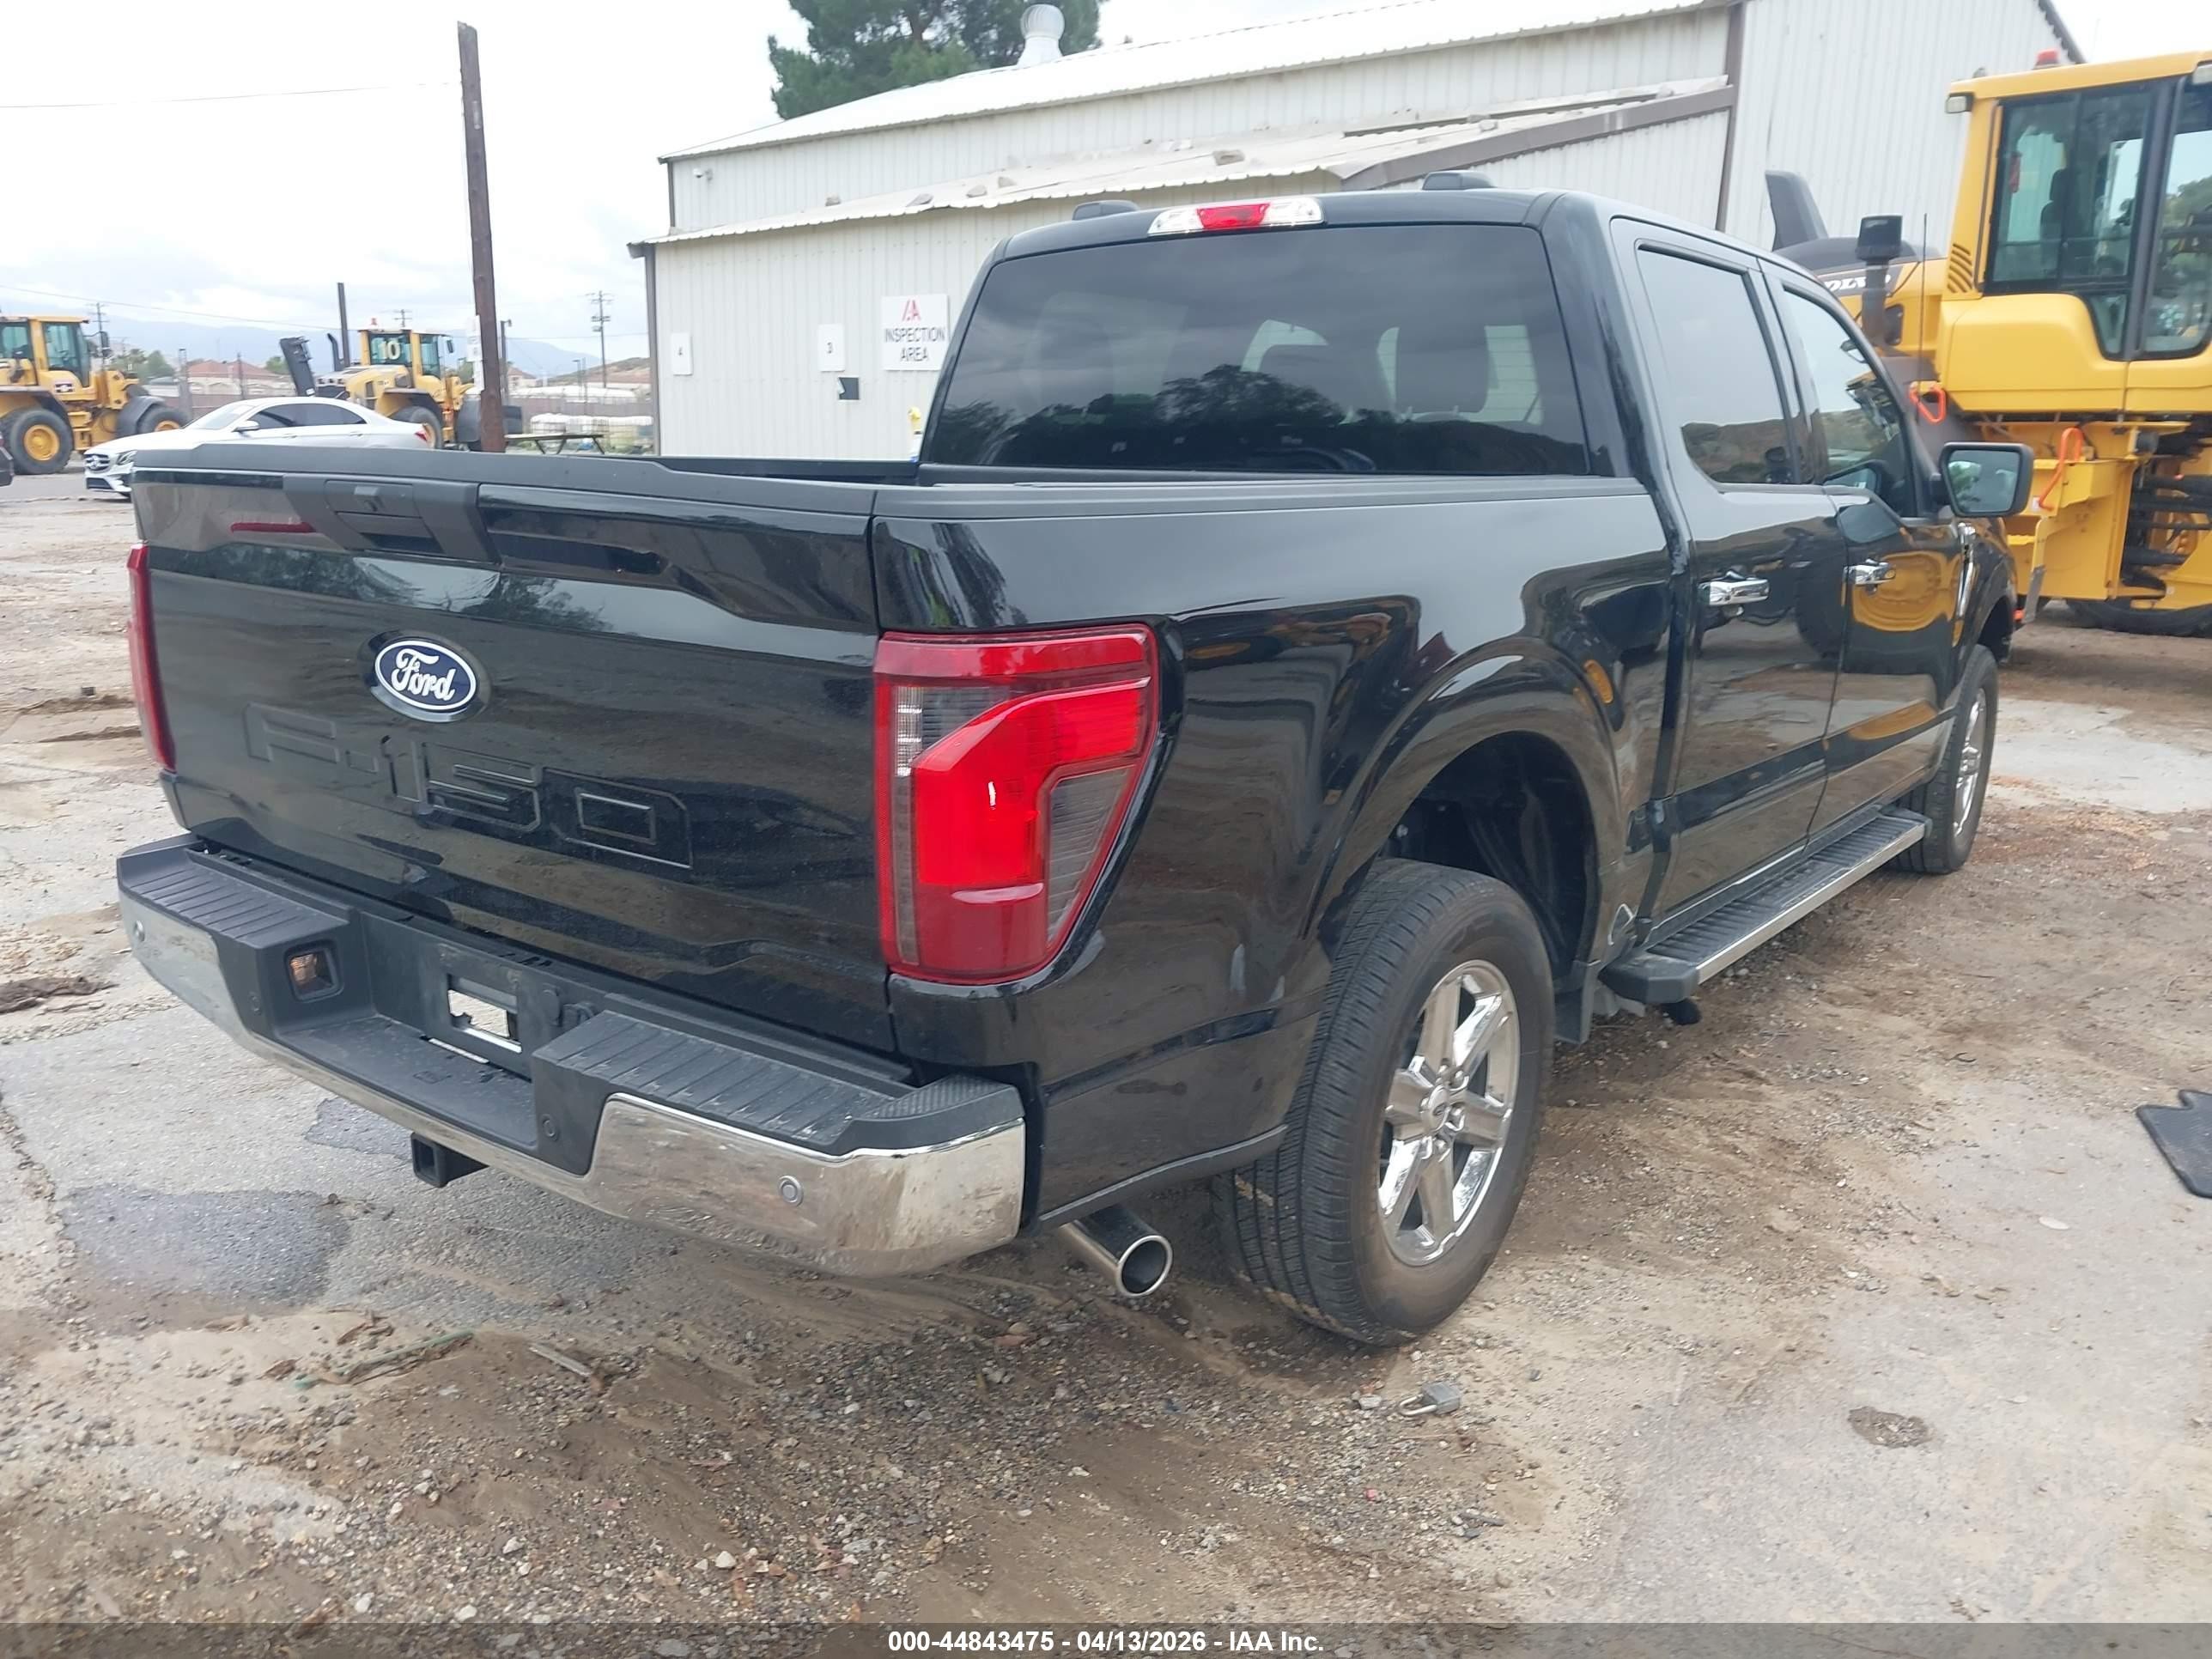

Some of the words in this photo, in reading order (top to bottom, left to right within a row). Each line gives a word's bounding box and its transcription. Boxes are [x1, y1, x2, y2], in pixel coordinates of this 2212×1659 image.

[884, 326, 945, 343] INSPECTION
[900, 346, 929, 362] AREA
[391, 647, 457, 701] Ford
